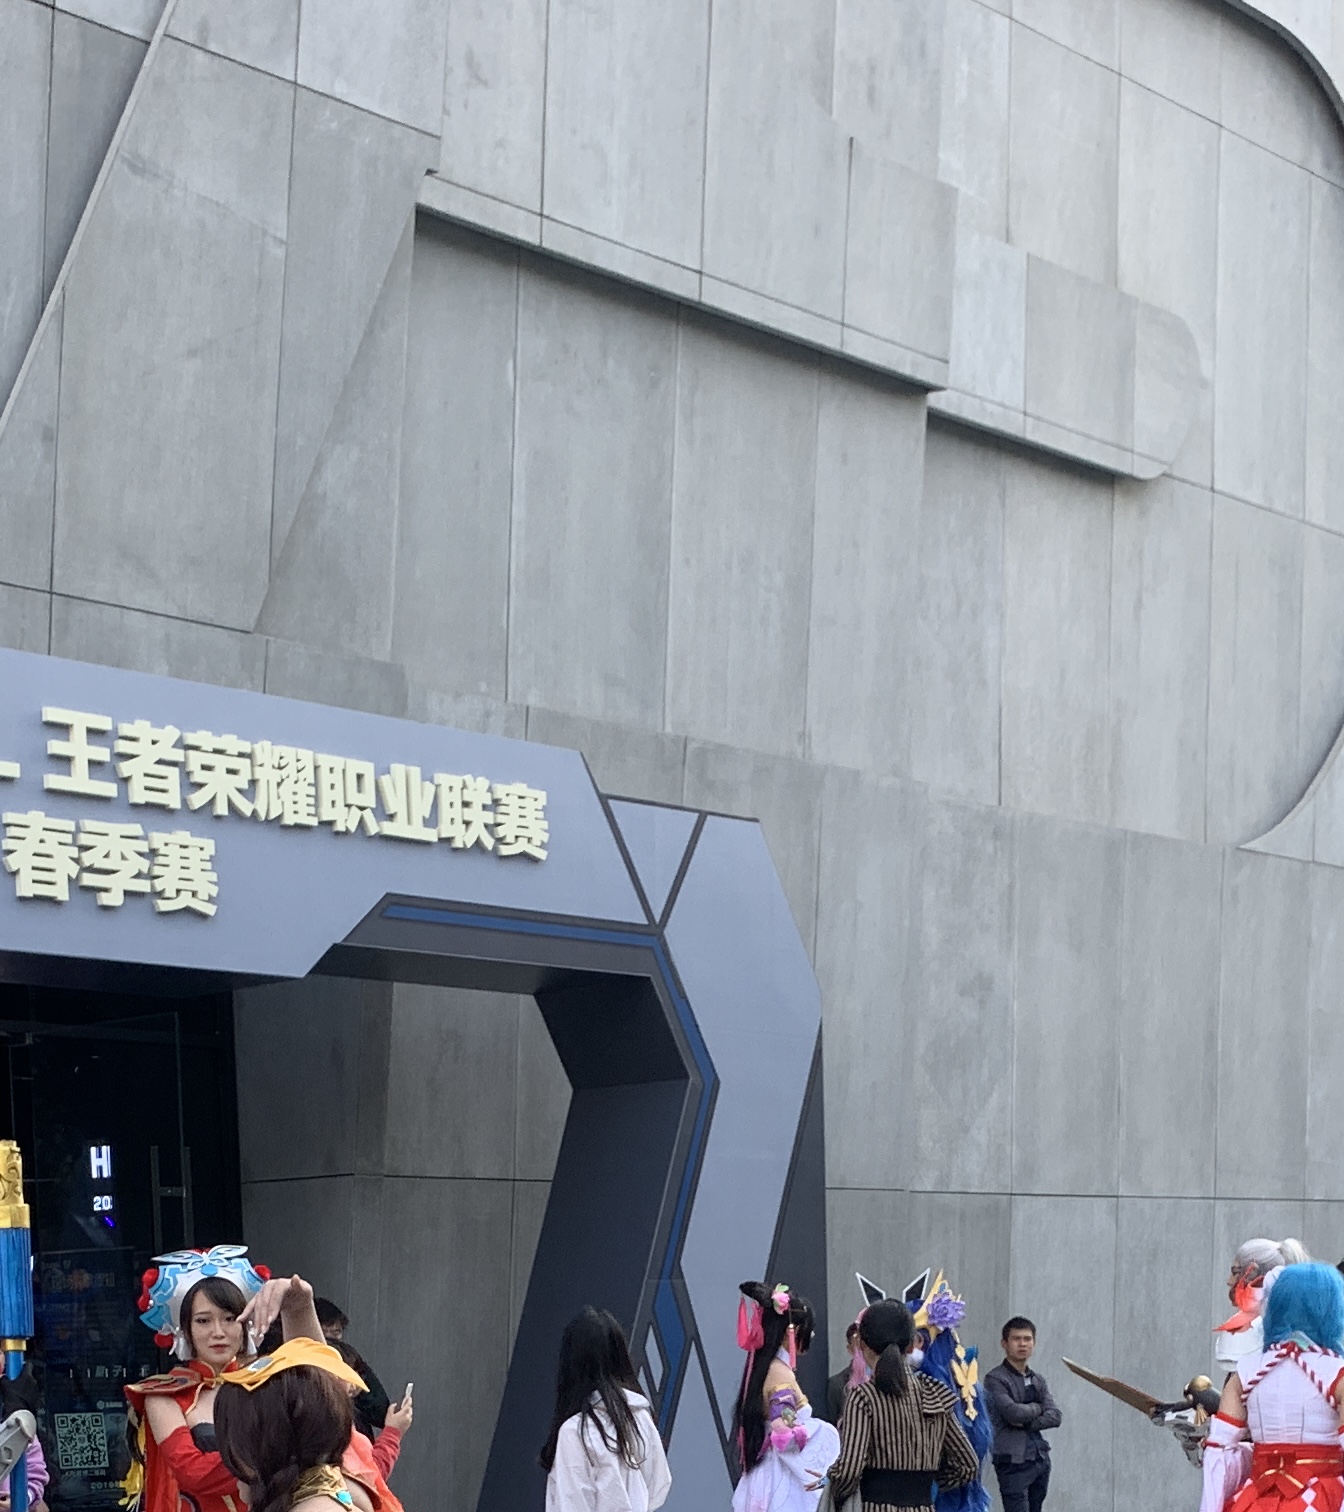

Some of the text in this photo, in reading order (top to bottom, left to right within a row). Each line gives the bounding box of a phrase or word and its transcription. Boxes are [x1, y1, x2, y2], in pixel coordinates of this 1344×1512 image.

[41, 706, 550, 862] 王者荣耀职业联赛
[2, 810, 220, 917] 春季赛
